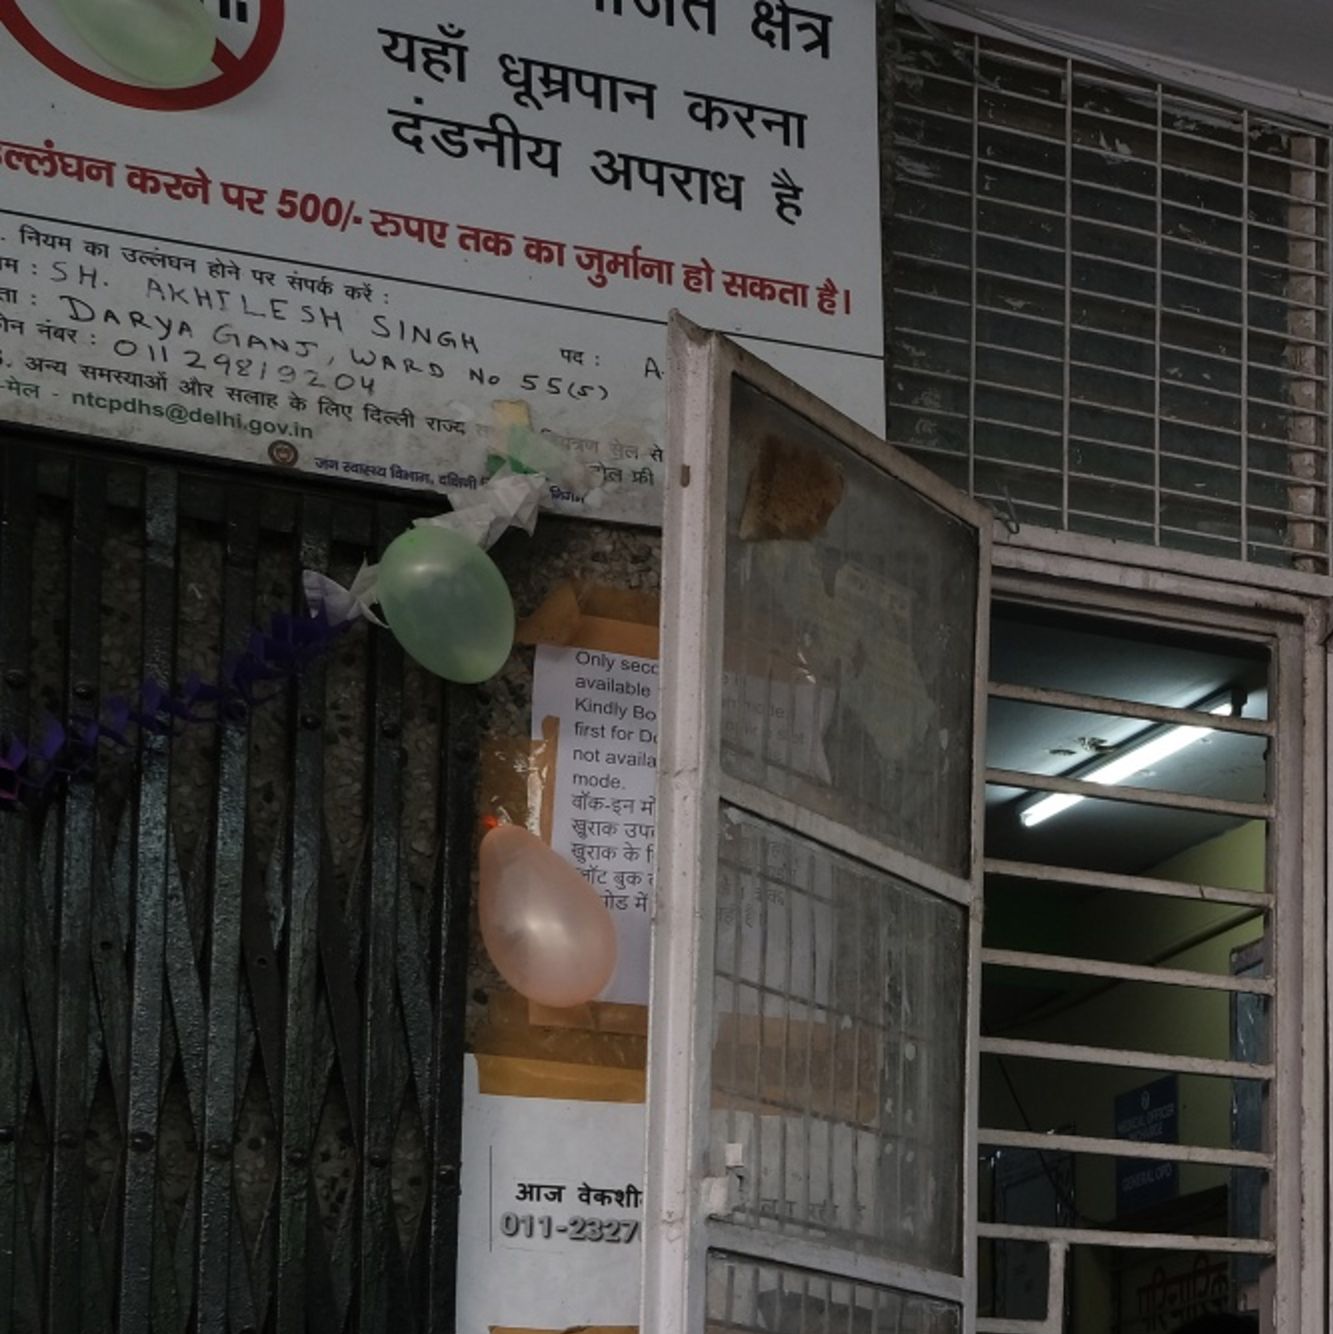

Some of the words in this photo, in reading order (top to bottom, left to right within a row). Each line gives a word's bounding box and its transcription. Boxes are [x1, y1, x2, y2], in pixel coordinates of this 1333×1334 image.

[377, 23, 468, 83] यहाँ
[499, 53, 658, 120] धूम्रपान
[683, 90, 808, 149] करना
[387, 96, 562, 178] दंडनीय
[590, 149, 745, 211] अपराध
[770, 167, 804, 225] है
[0, 139, 116, 187] ल्लंघन
[124, 166, 210, 205] करने
[219, 182, 268, 216] पर
[276, 189, 363, 232] 500/-
[368, 208, 448, 249] रुपए
[456, 224, 516, 257] तक
[523, 235, 565, 267] का
[573, 245, 674, 289] जुर्माना
[682, 257, 715, 293] हो
[721, 270, 812, 309] सकता
[19, 223, 72, 250] नियम
[82, 239, 110, 259] का
[121, 246, 197, 274] उल्लंघन
[207, 256, 241, 281] होने
[251, 269, 276, 287] पर
[286, 267, 335, 297] संपर्क
[36, 318, 78, 344] नंबर
[59, 295, 194, 341] DARYA
[351, 349, 446, 380] WARD
[372, 315, 479, 354] SINGH
[559, 348, 584, 366] पद
[24, 356, 68, 377] अन्य
[179, 376, 215, 399] और
[227, 385, 279, 410] सलाह
[289, 391, 307, 411] के
[318, 396, 354, 421] लिए
[363, 403, 415, 430] दिल्ली
[71, 392, 314, 439] ntcpdhs@delhi.gov.in
[575, 651, 615, 672] Only
[575, 677, 651, 698] available
[574, 697, 628, 721] Kindly
[573, 721, 606, 739] first
[610, 725, 634, 741] for
[573, 749, 600, 763] not
[572, 772, 626, 791] mode.
[571, 819, 619, 840] खुराक
[623, 823, 654, 839] उप
[571, 843, 618, 864] खुराक
[623, 841, 642, 862] के
[612, 871, 642, 890] बुक
[634, 891, 648, 912] में
[515, 1183, 566, 1203] आज
[577, 1182, 642, 1208] वेकशी
[500, 1213, 642, 1243] 011-2327
